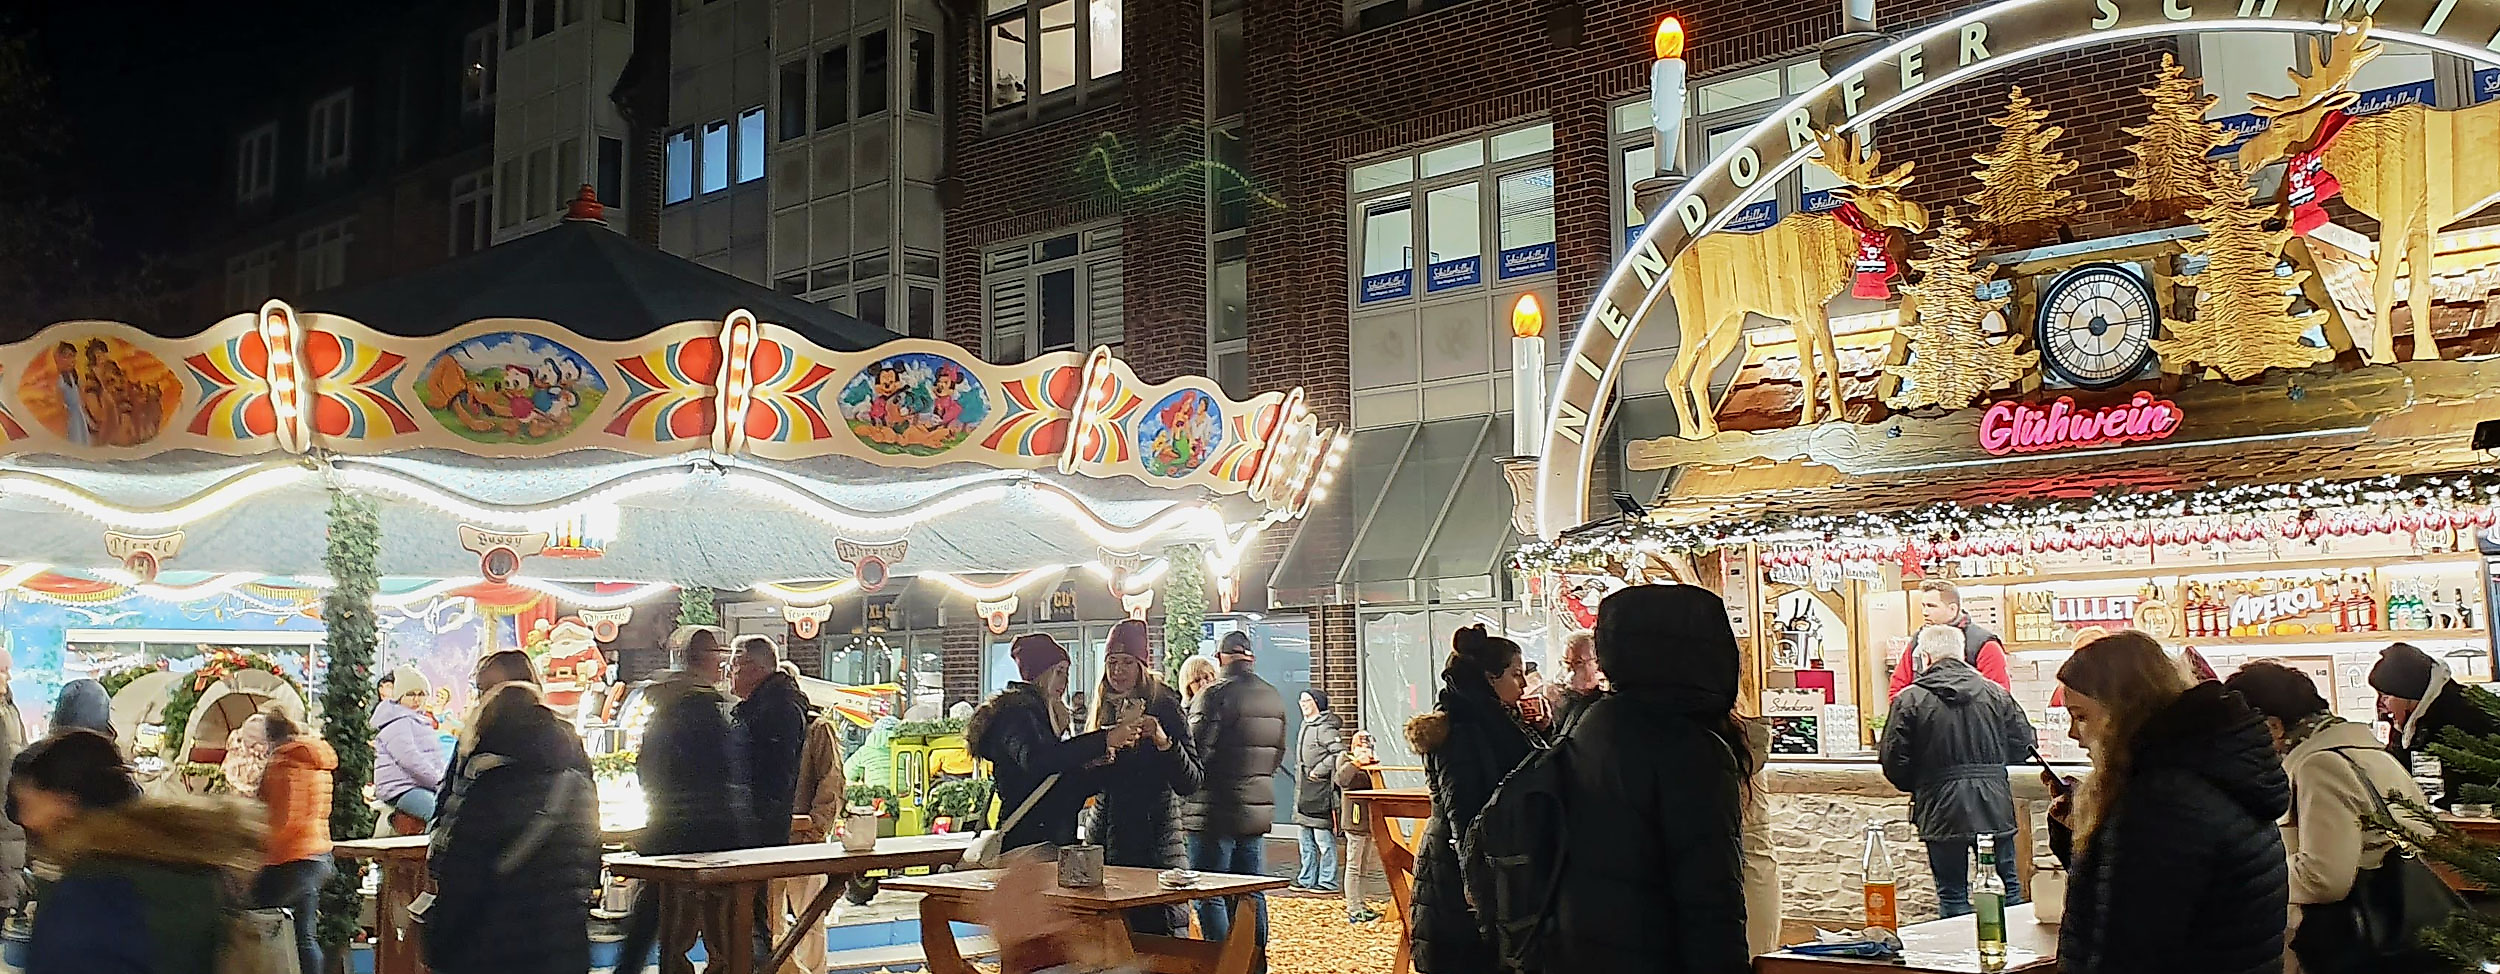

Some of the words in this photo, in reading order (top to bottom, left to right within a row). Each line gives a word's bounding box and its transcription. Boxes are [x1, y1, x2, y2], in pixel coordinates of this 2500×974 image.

[1555, 21, 1992, 445] NIENDORFER
[2091, 0, 2500, 53] SCHWI
[1980, 396, 2176, 451] Glühwein
[110, 536, 171, 553] Pferde
[2052, 596, 2134, 621] LILLET
[2230, 585, 2324, 627] APEROL
